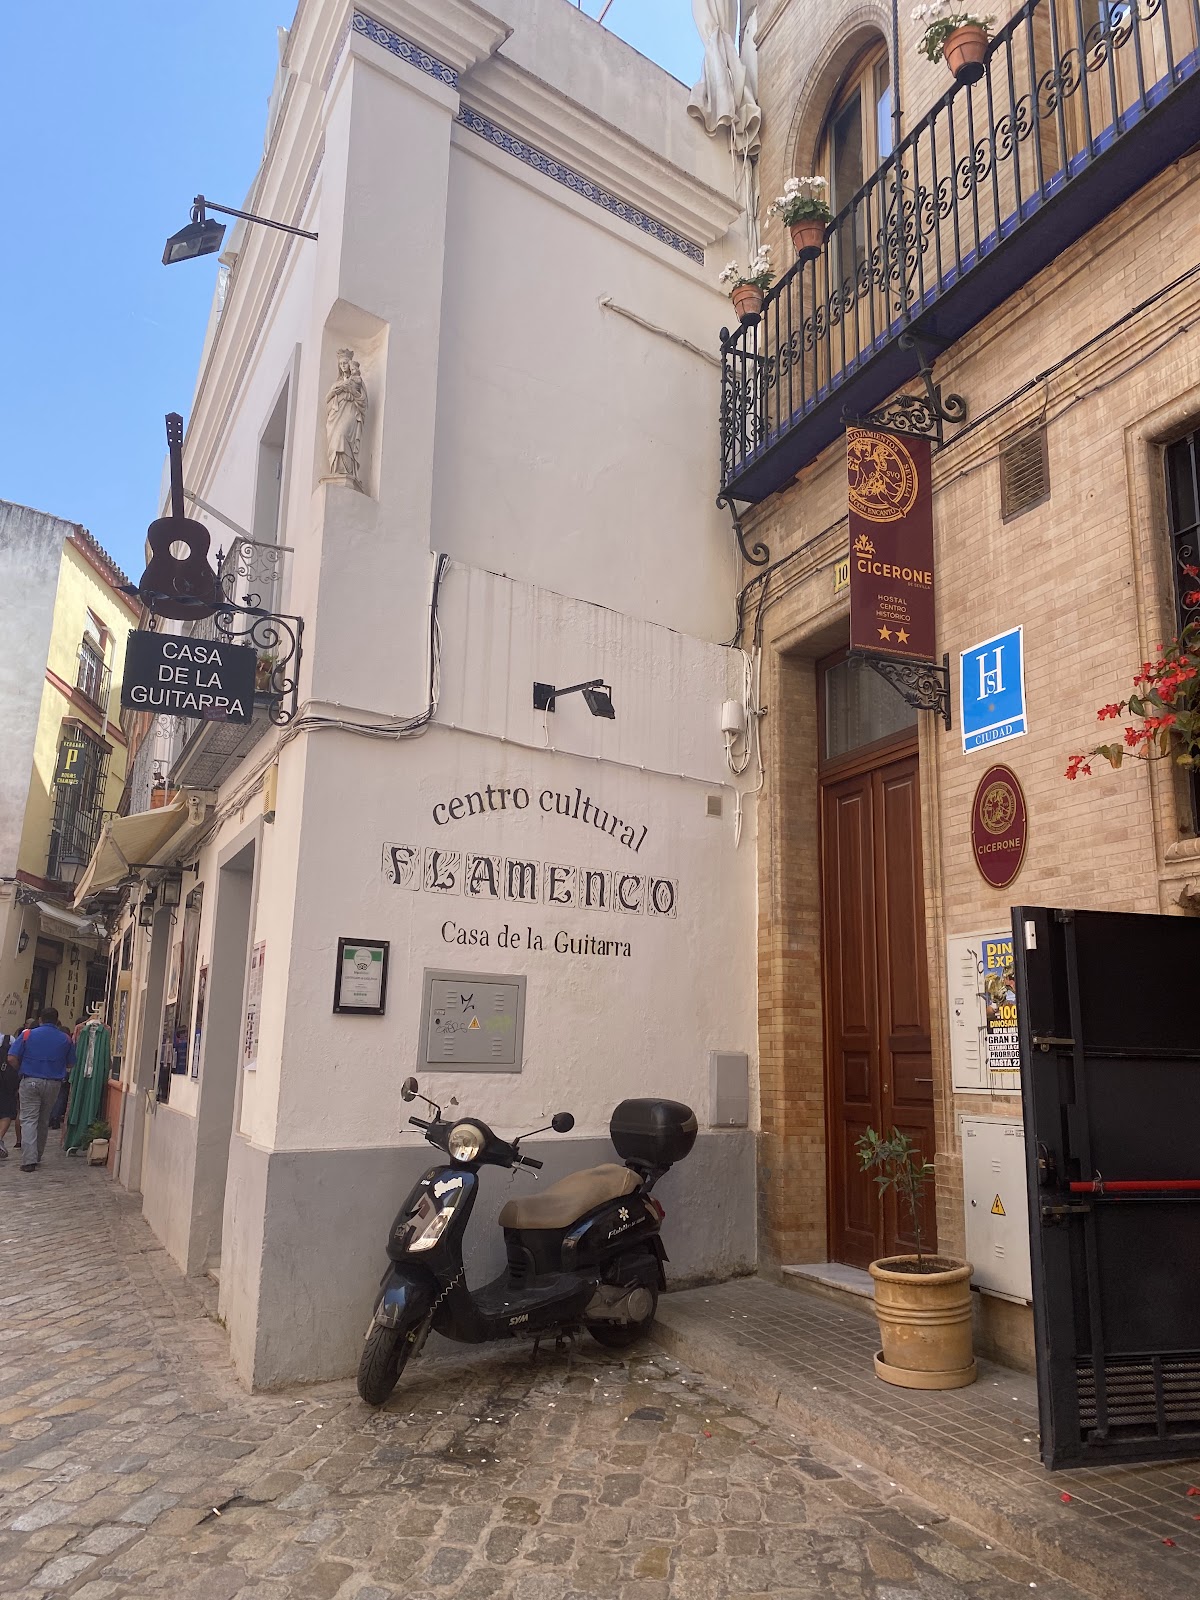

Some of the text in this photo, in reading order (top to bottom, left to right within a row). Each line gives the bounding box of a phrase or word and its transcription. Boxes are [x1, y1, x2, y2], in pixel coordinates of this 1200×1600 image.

[847, 431, 899, 452] ALOJAMIENTOS
[886, 470, 901, 480] SVQ
[903, 463, 913, 498] SEVILLA
[853, 500, 867, 512] CON
[838, 563, 848, 585] 10
[857, 559, 933, 585] CICERONE
[914, 582, 931, 590] SEVILLA
[877, 594, 907, 606] HOSTAL
[879, 602, 907, 613] CENTRO
[162, 642, 223, 667] CASA
[158, 664, 223, 690] DE LA
[130, 685, 245, 716] GUITARRA
[975, 724, 1013, 746] CIUDAD
[64, 748, 79, 770] P
[432, 783, 649, 854] centro cultural
[978, 837, 1021, 855] CICERONE
[441, 920, 633, 958] Casa de la Guitarra
[64, 969, 73, 1007] BAR
[69, 959, 82, 1020] TAPAS
[988, 1036, 1009, 1044] GRAN
[990, 1059, 1012, 1067] HASTA
[508, 1313, 529, 1326] SYM
